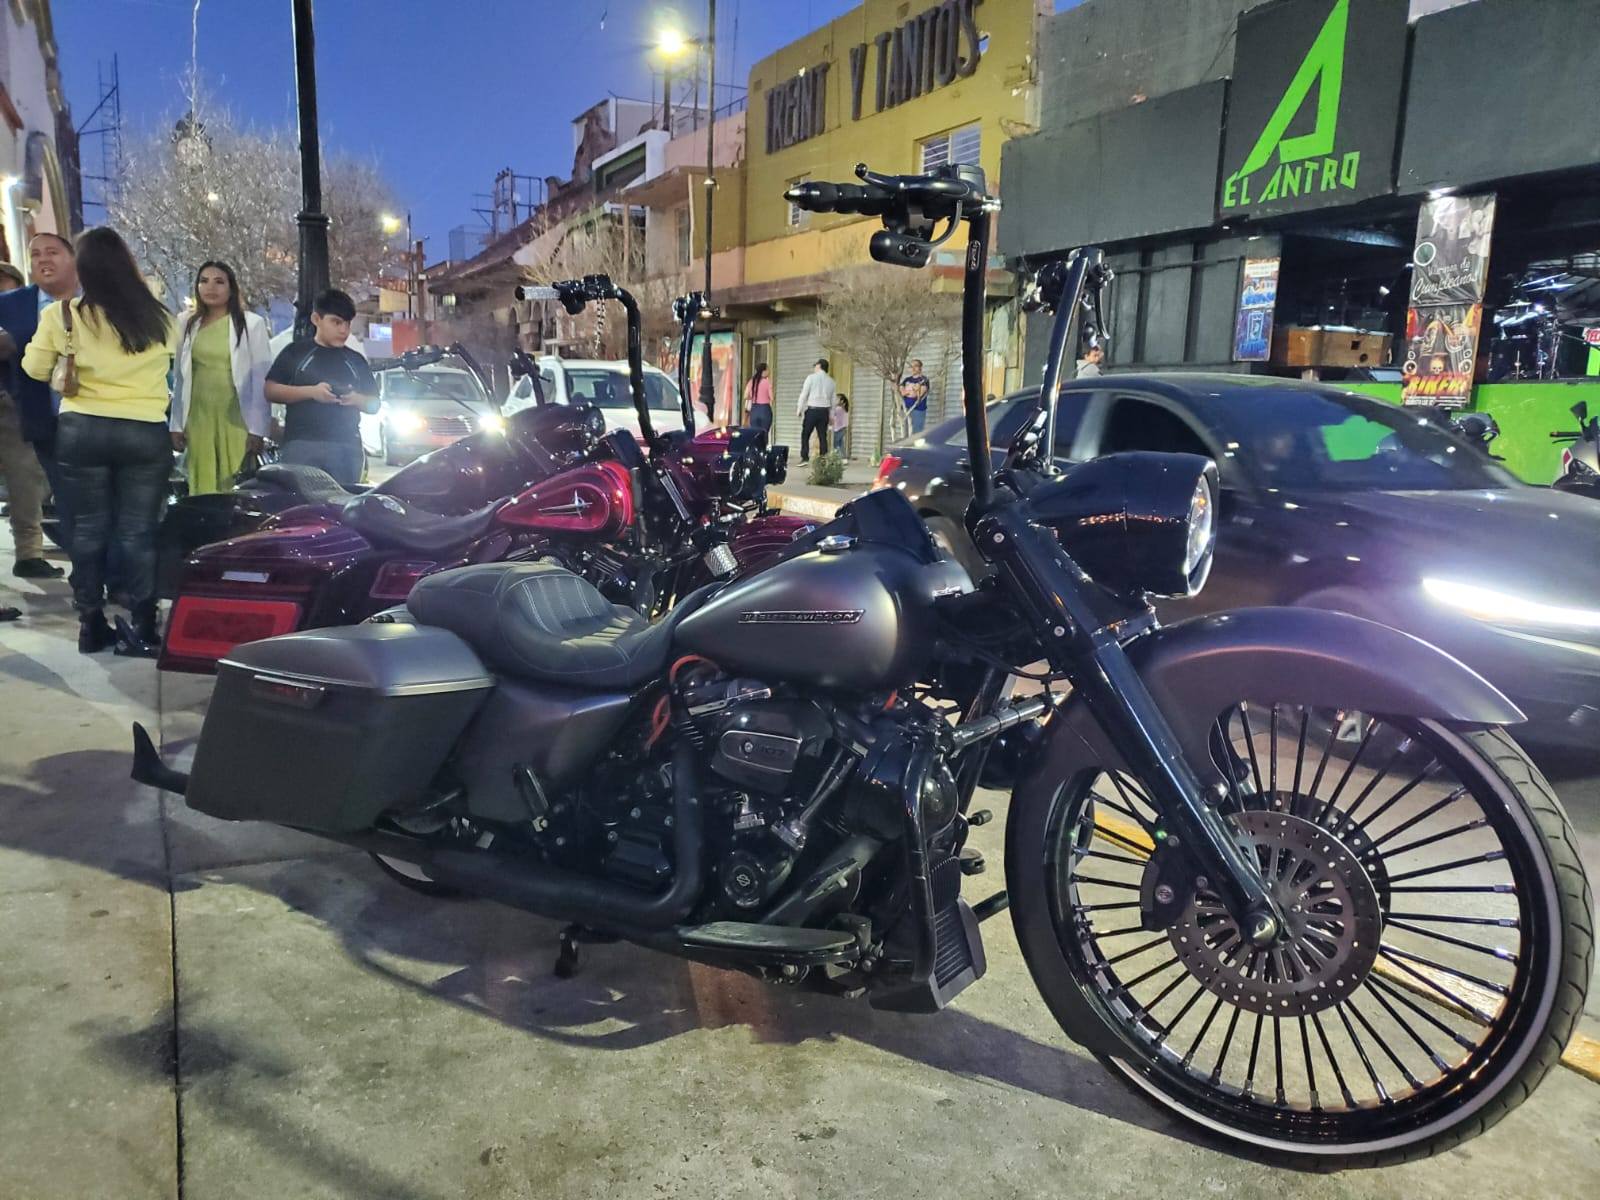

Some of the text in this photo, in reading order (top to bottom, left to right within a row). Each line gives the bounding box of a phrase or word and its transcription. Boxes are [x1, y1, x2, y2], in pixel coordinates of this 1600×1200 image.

[849, 43, 867, 121] Y
[874, 0, 983, 112] TANTOS
[1223, 151, 1360, 207] EL ANTRO
